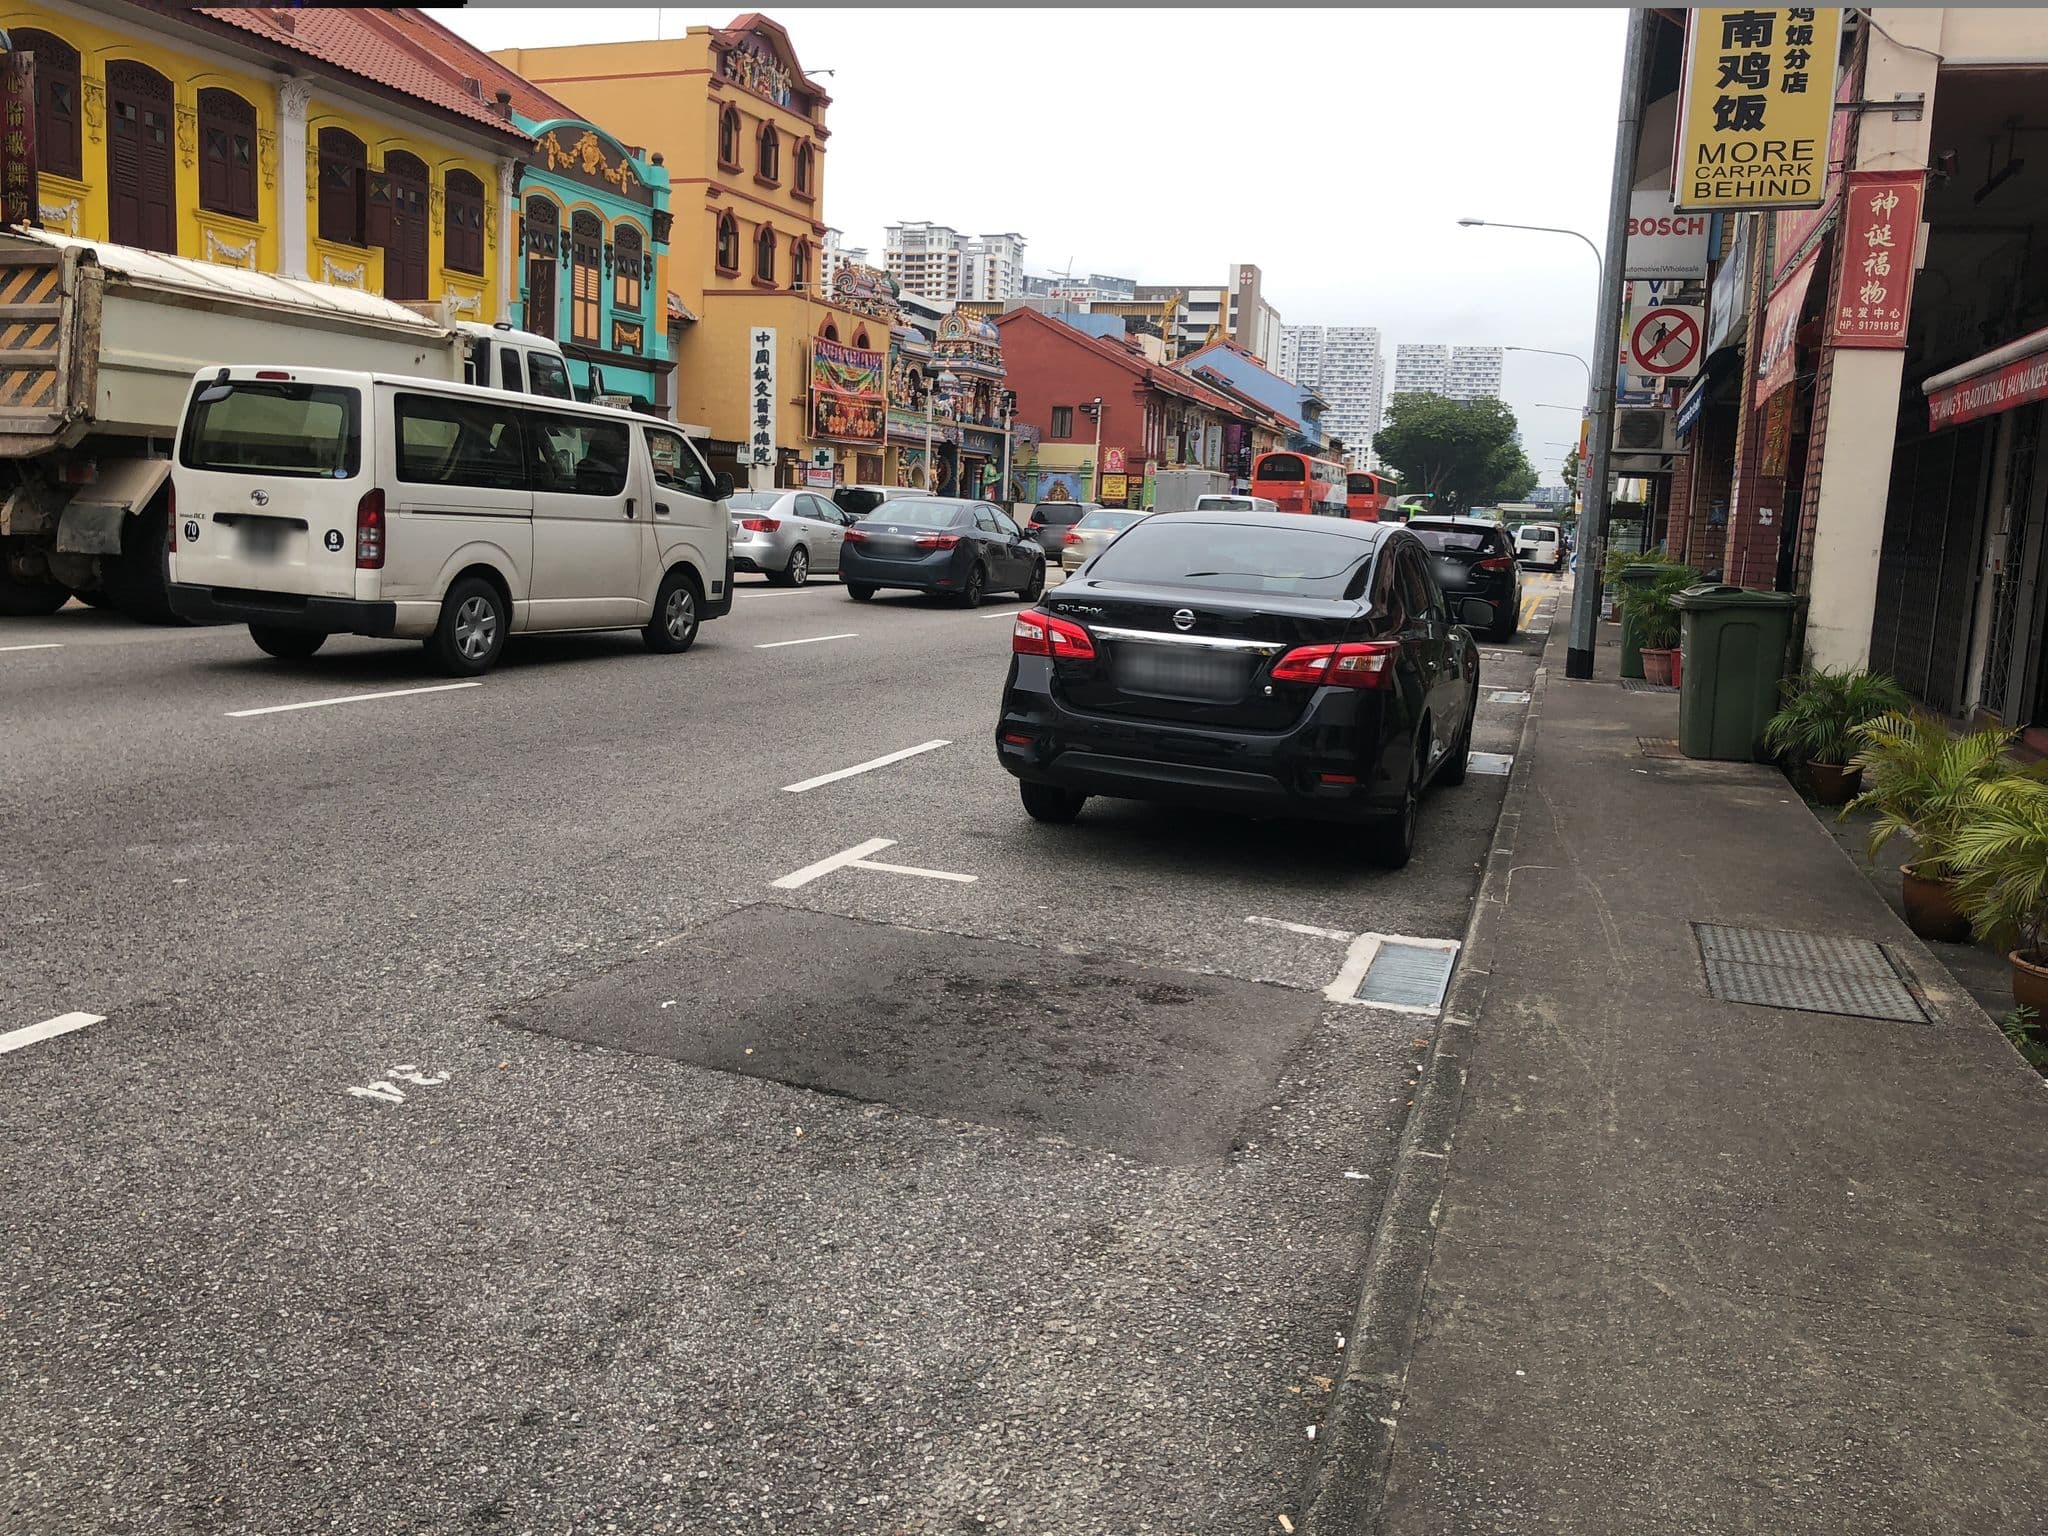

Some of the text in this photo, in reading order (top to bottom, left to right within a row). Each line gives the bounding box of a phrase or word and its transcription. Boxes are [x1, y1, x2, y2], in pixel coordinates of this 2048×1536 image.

[1713, 10, 1777, 132] 南鸡饭
[1698, 140, 1815, 164] MORE
[1695, 163, 1812, 179] CARPARK
[1694, 179, 1811, 198] BEHIND
[1625, 217, 1704, 236] BOSCH
[1842, 306, 1901, 319] 批发中心
[1839, 320, 1900, 331] HP: 91791818
[1962, 379, 2006, 412] TRADITIONAL
[187, 522, 197, 536] 70
[330, 531, 338, 544] 8
[1056, 603, 1103, 615] SYLPHY
